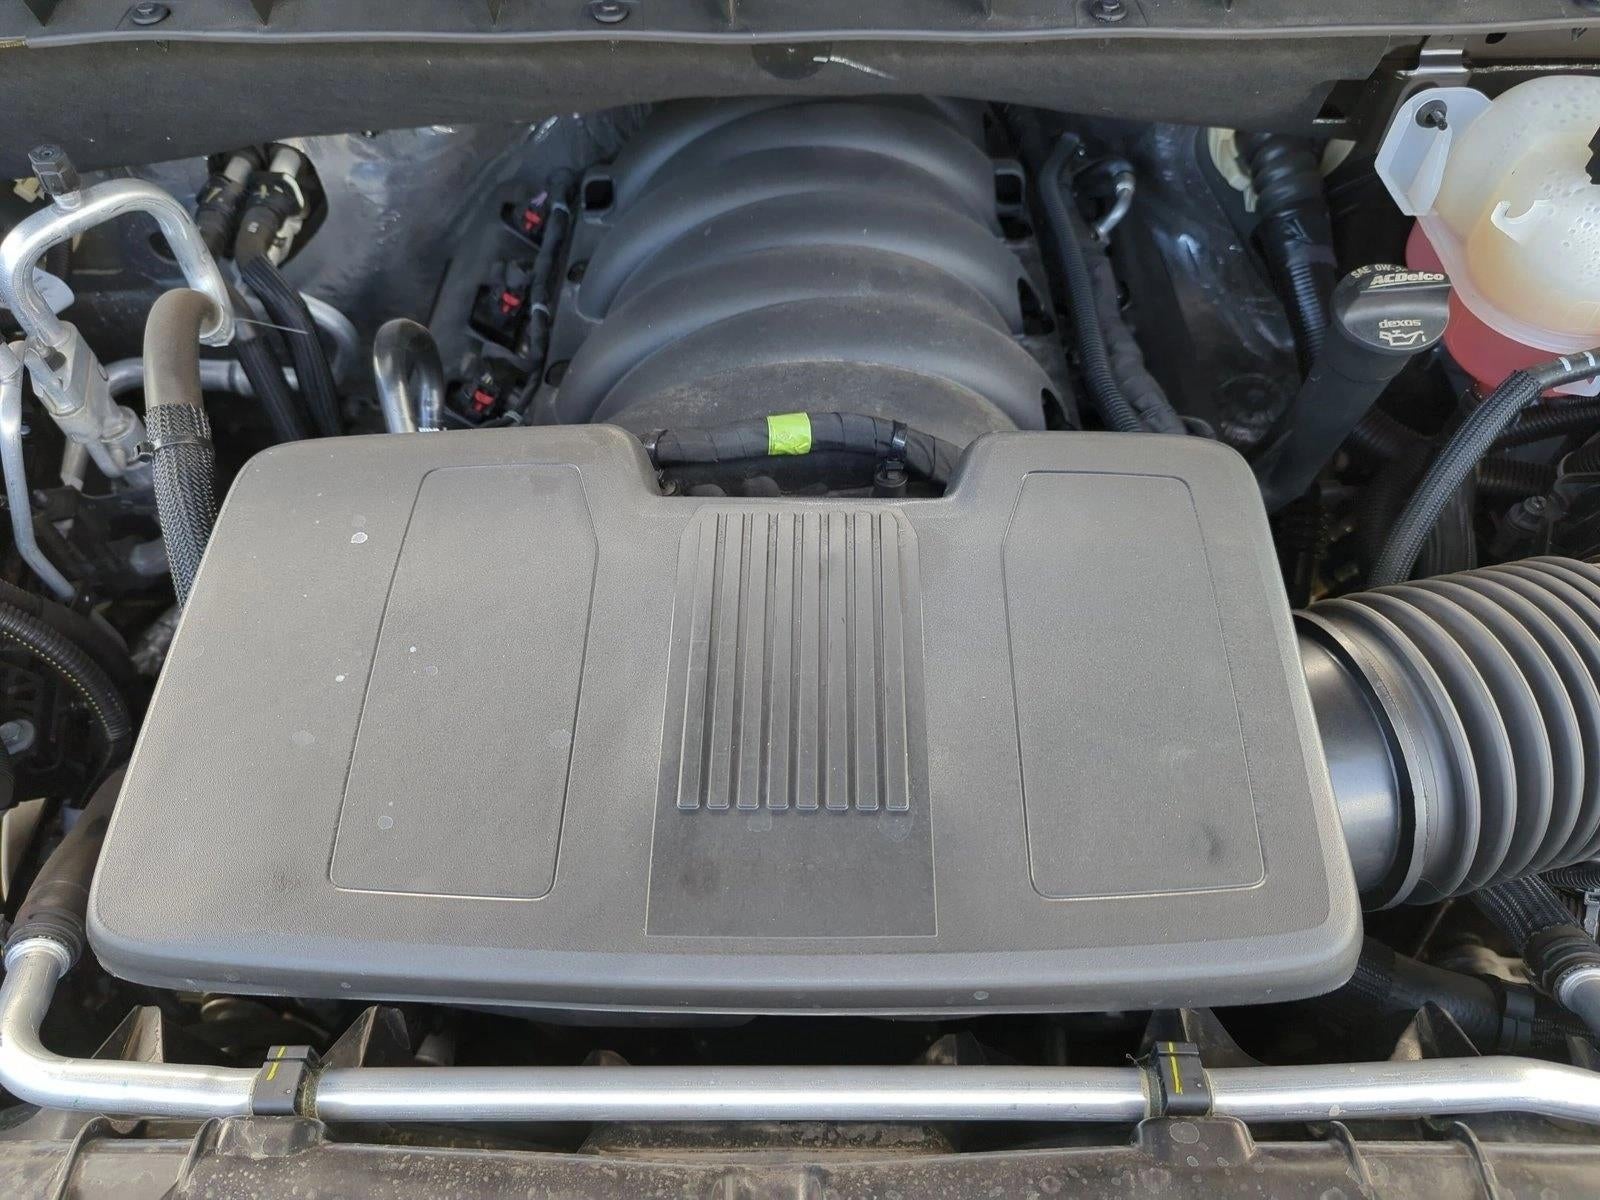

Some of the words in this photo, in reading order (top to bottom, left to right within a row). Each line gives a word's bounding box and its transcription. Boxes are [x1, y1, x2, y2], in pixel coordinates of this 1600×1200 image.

[1350, 266, 1372, 278] SAE
[1370, 272, 1445, 286] ACDelco
[1379, 319, 1421, 328] dexos
